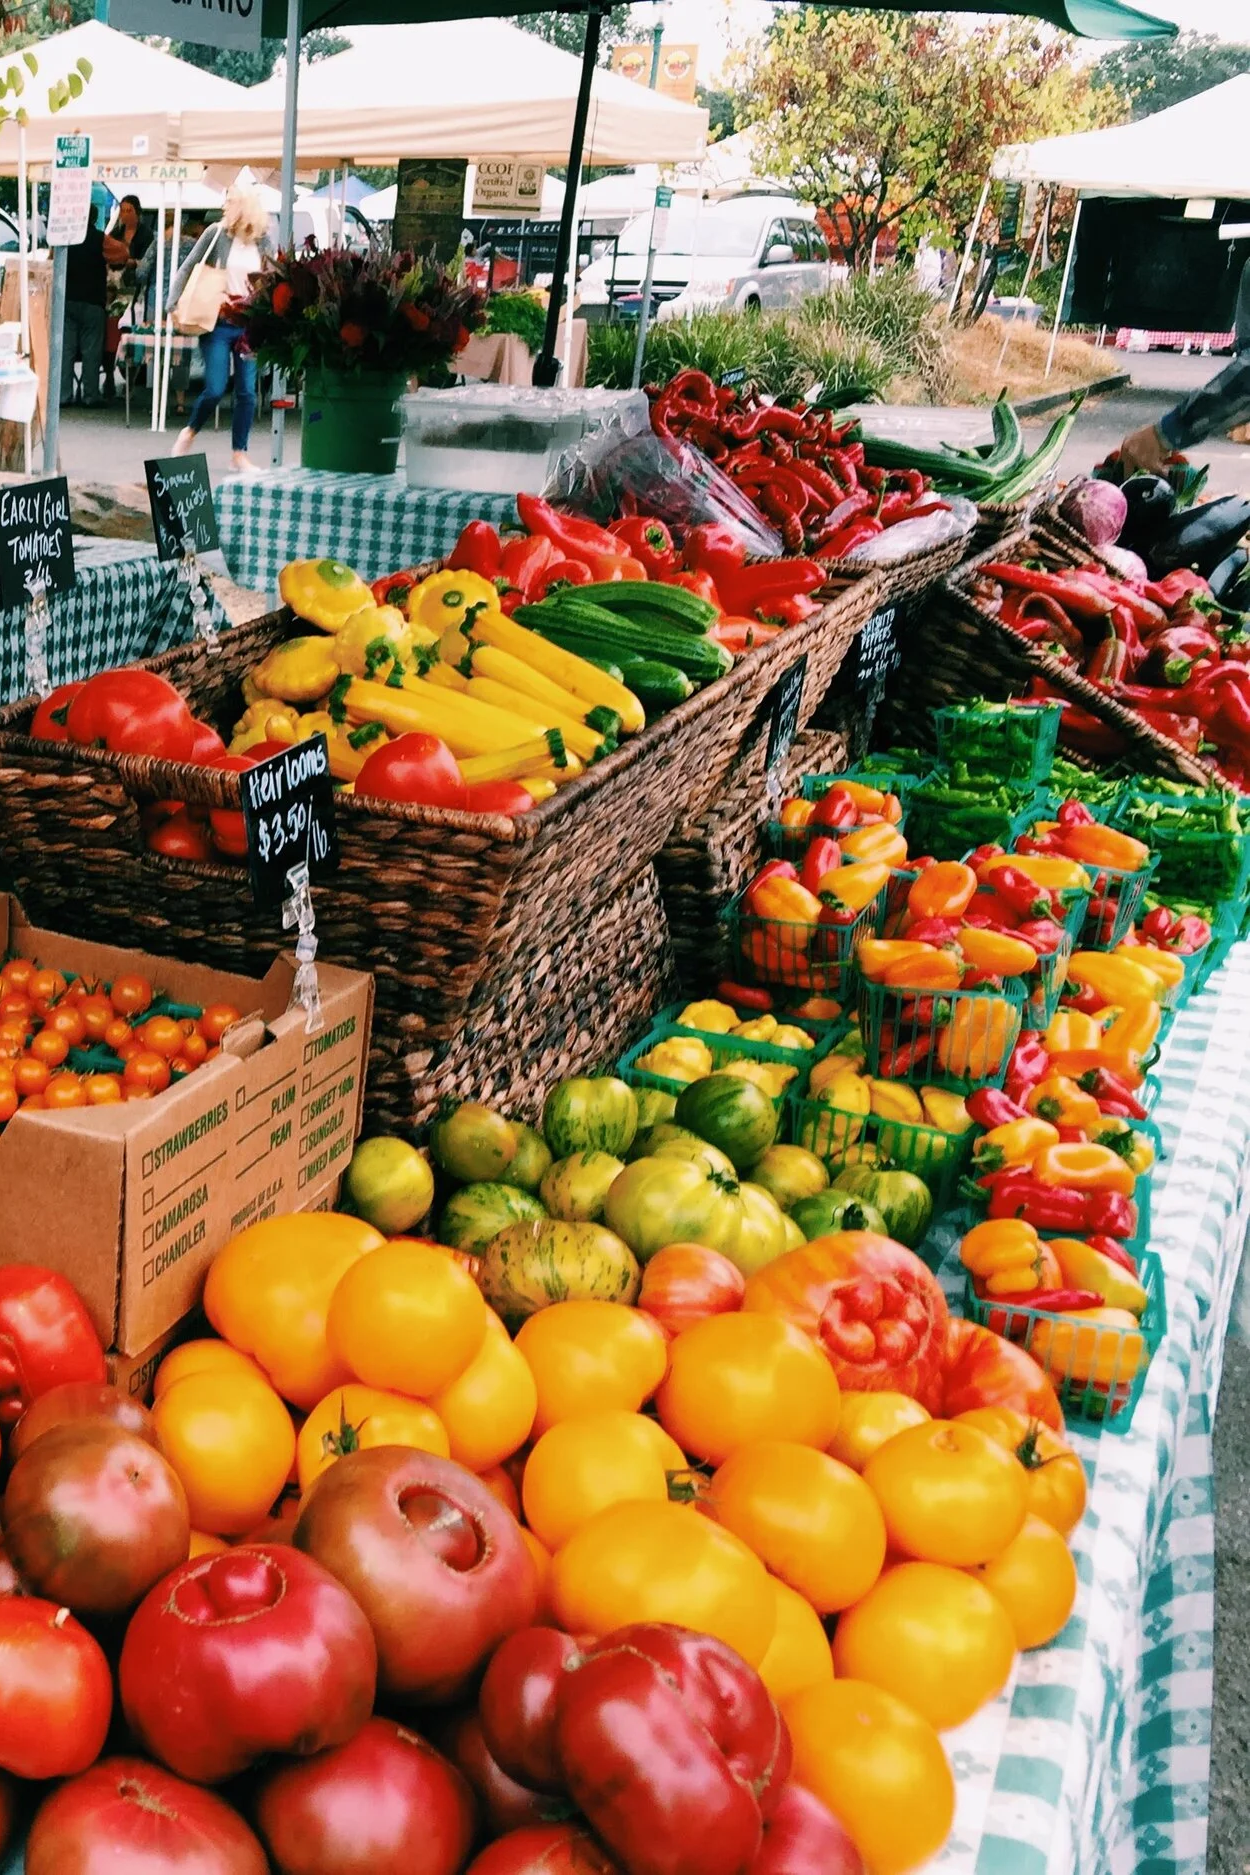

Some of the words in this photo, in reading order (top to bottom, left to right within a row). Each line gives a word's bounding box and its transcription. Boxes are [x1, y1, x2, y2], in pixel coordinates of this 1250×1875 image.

[150, 166, 188, 179] FARM
[476, 176, 513, 187] Certified
[478, 162, 515, 175] CCOF
[476, 187, 510, 200] Organic
[1, 491, 40, 527] EARLY
[7, 528, 63, 564] TOMATOES
[250, 744, 327, 810] Heirlooms
[312, 1015, 356, 1057] TOMATOES
[271, 1085, 296, 1116] PLUM
[310, 1087, 337, 1122] SWEET
[154, 1099, 228, 1170] STRAWBERRIES
[270, 1119, 292, 1150] PEAR
[308, 1108, 344, 1150] SUNGOLD
[155, 1183, 209, 1242] CAMAROSA
[155, 1219, 206, 1277] CHANDLER
